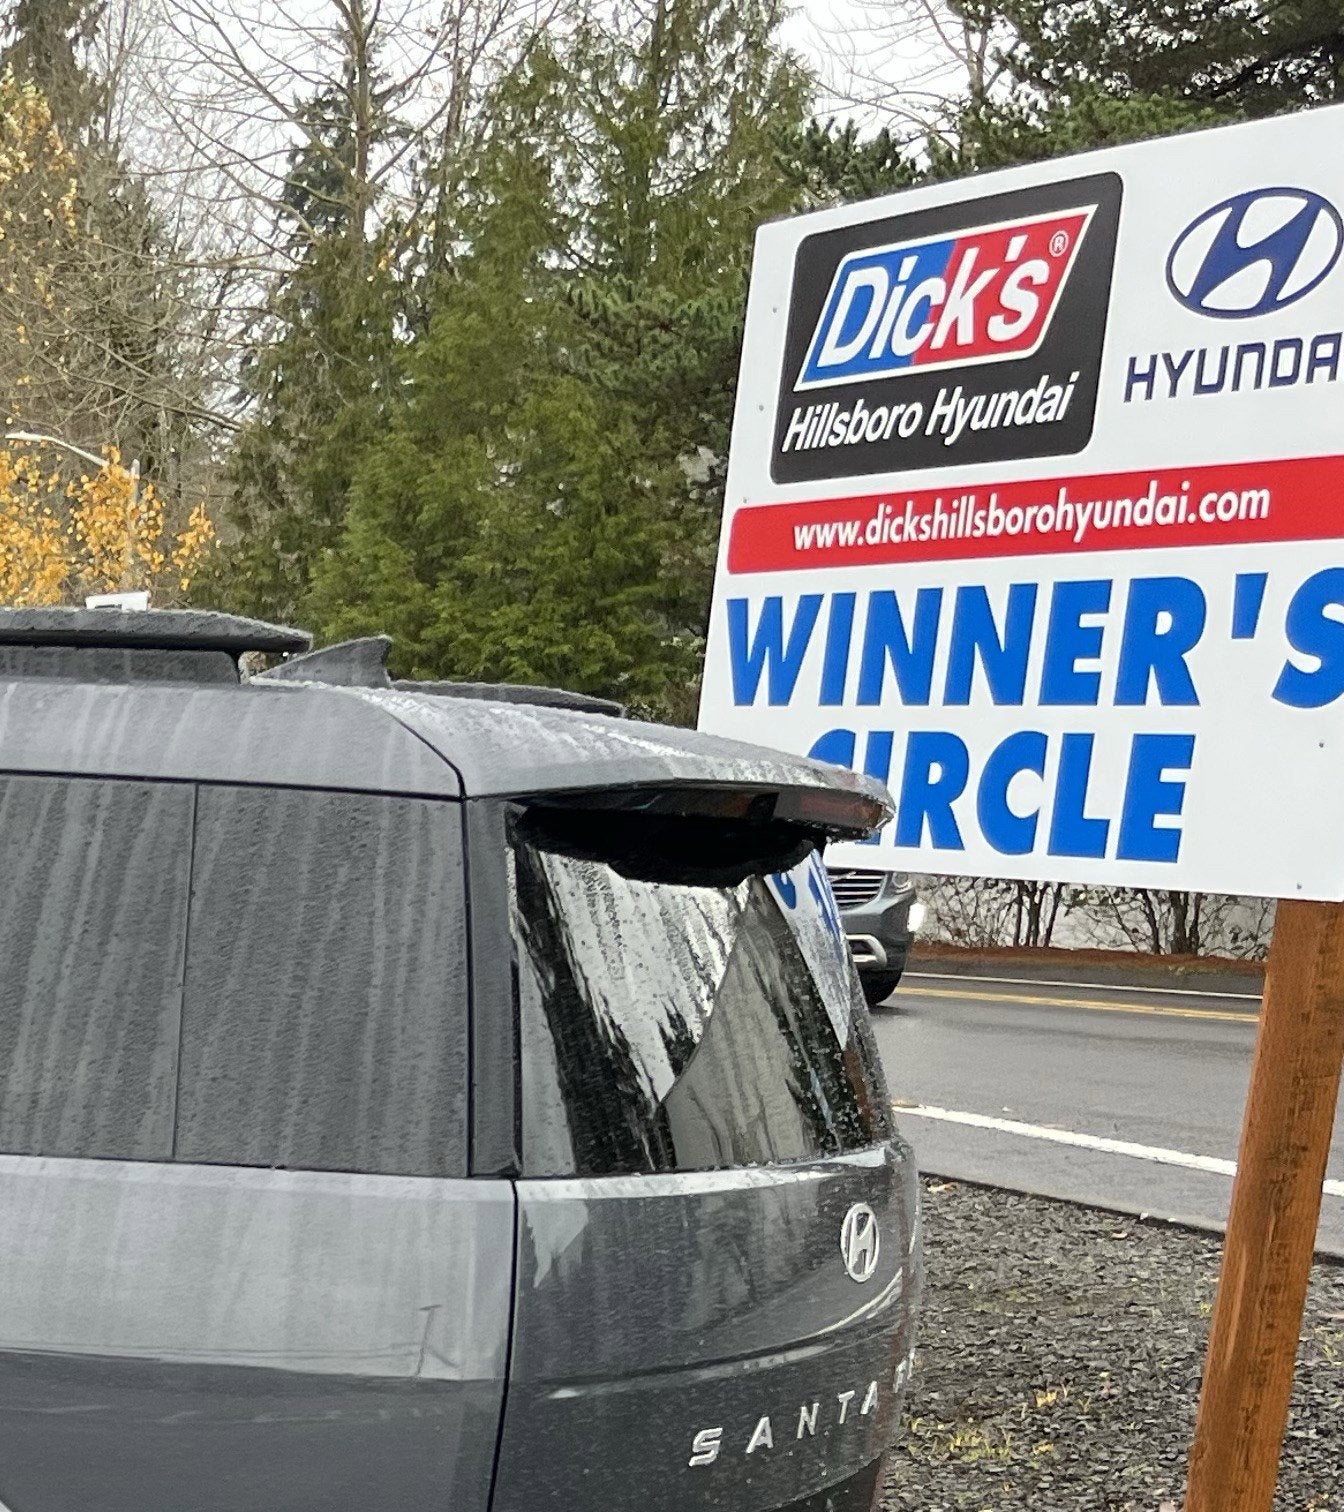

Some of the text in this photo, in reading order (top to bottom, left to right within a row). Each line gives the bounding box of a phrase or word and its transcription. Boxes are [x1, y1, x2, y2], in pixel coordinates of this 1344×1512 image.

[816, 234, 1050, 367] Dick's
[781, 370, 1081, 453] Hillsboro Hyundai
[793, 480, 1271, 551] www.dickshillsborohyundai.com
[726, 566, 1343, 708] WINNER'S
[688, 1380, 880, 1467] SANTA
